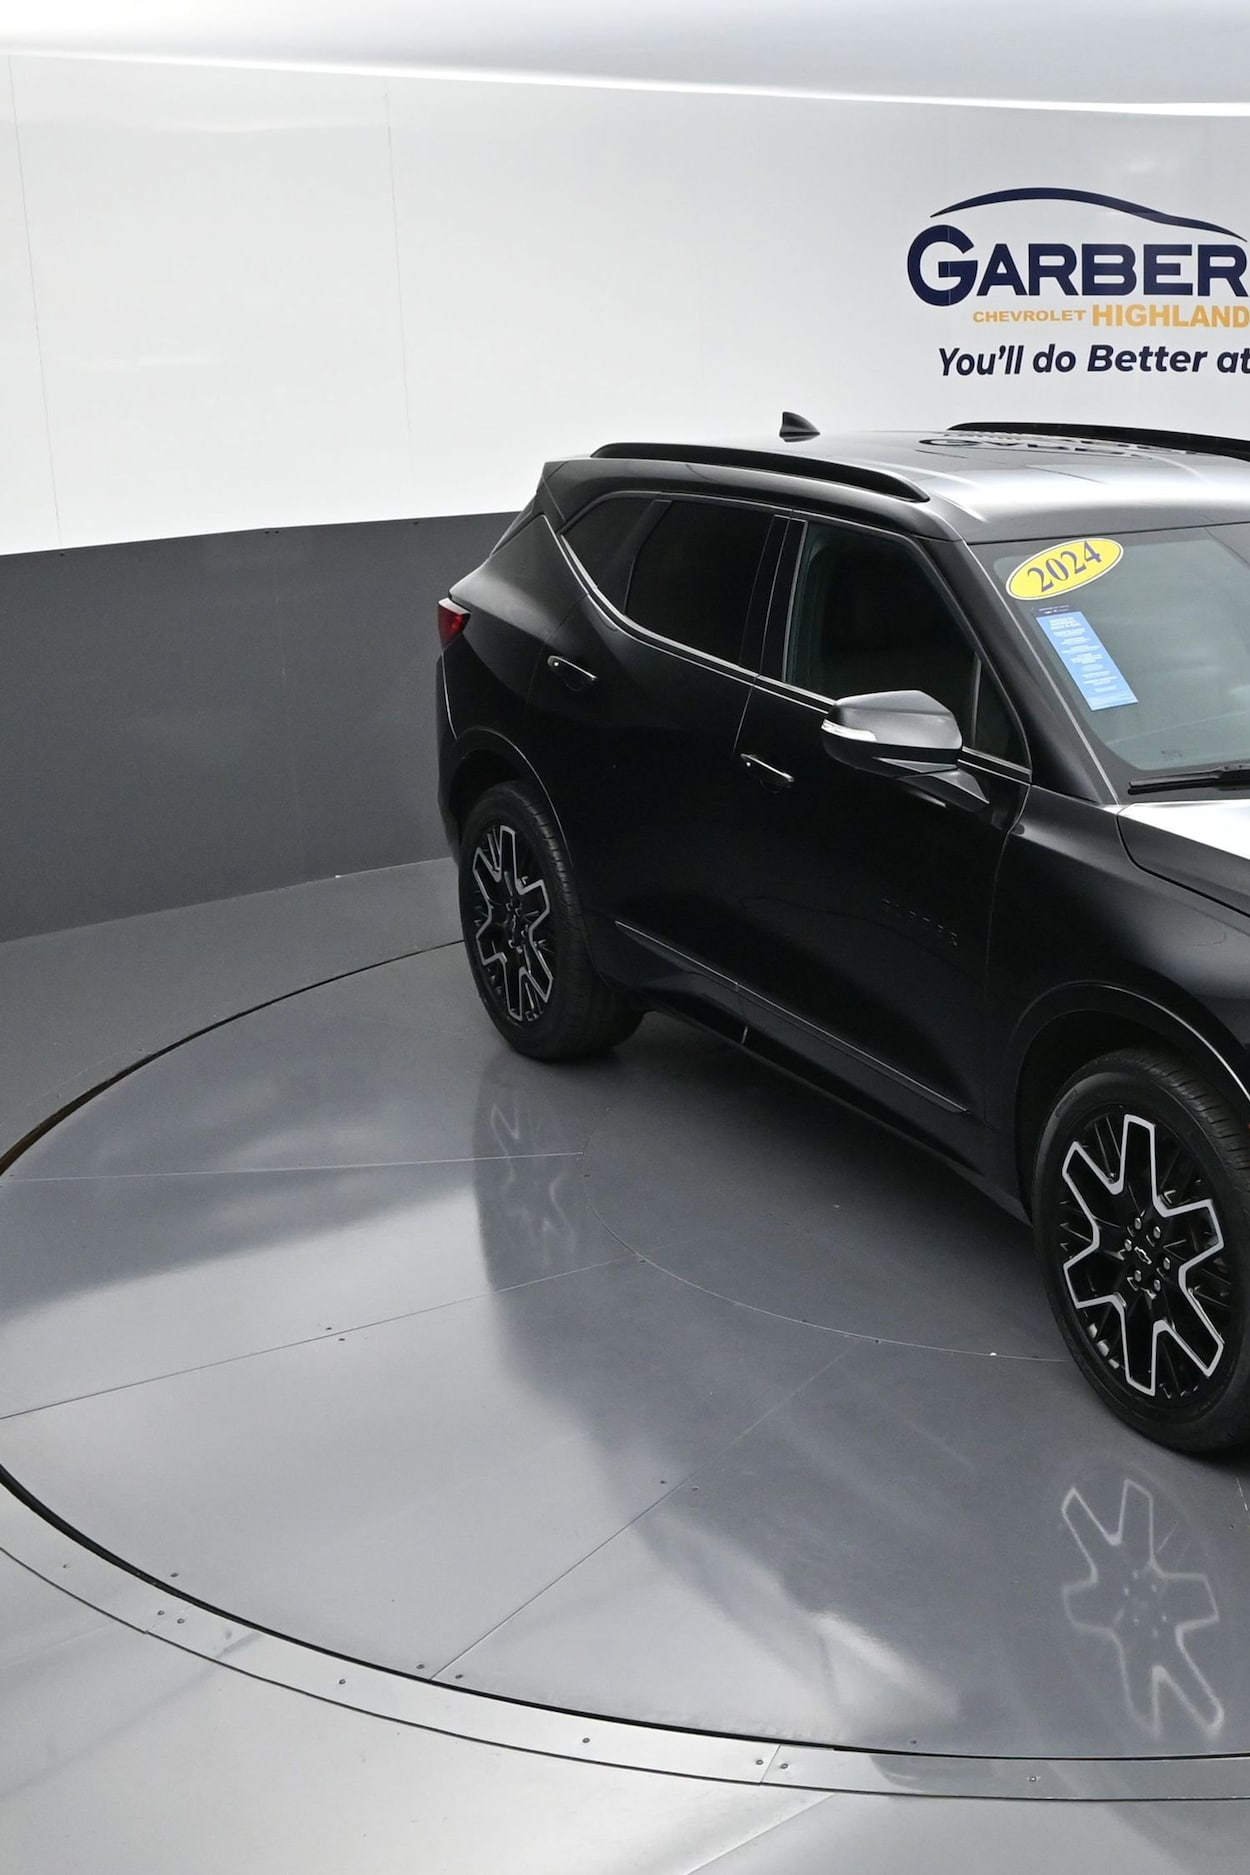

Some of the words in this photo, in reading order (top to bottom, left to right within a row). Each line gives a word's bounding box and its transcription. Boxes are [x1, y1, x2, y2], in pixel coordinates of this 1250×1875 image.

[906, 224, 1249, 307] GARBER
[973, 309, 1086, 323] CHEVROLET
[1092, 304, 1250, 328] HIGHLAND
[938, 344, 1025, 377] You'll
[1032, 343, 1077, 374] do
[1086, 344, 1208, 374] Better
[1027, 541, 1102, 592] 2024
